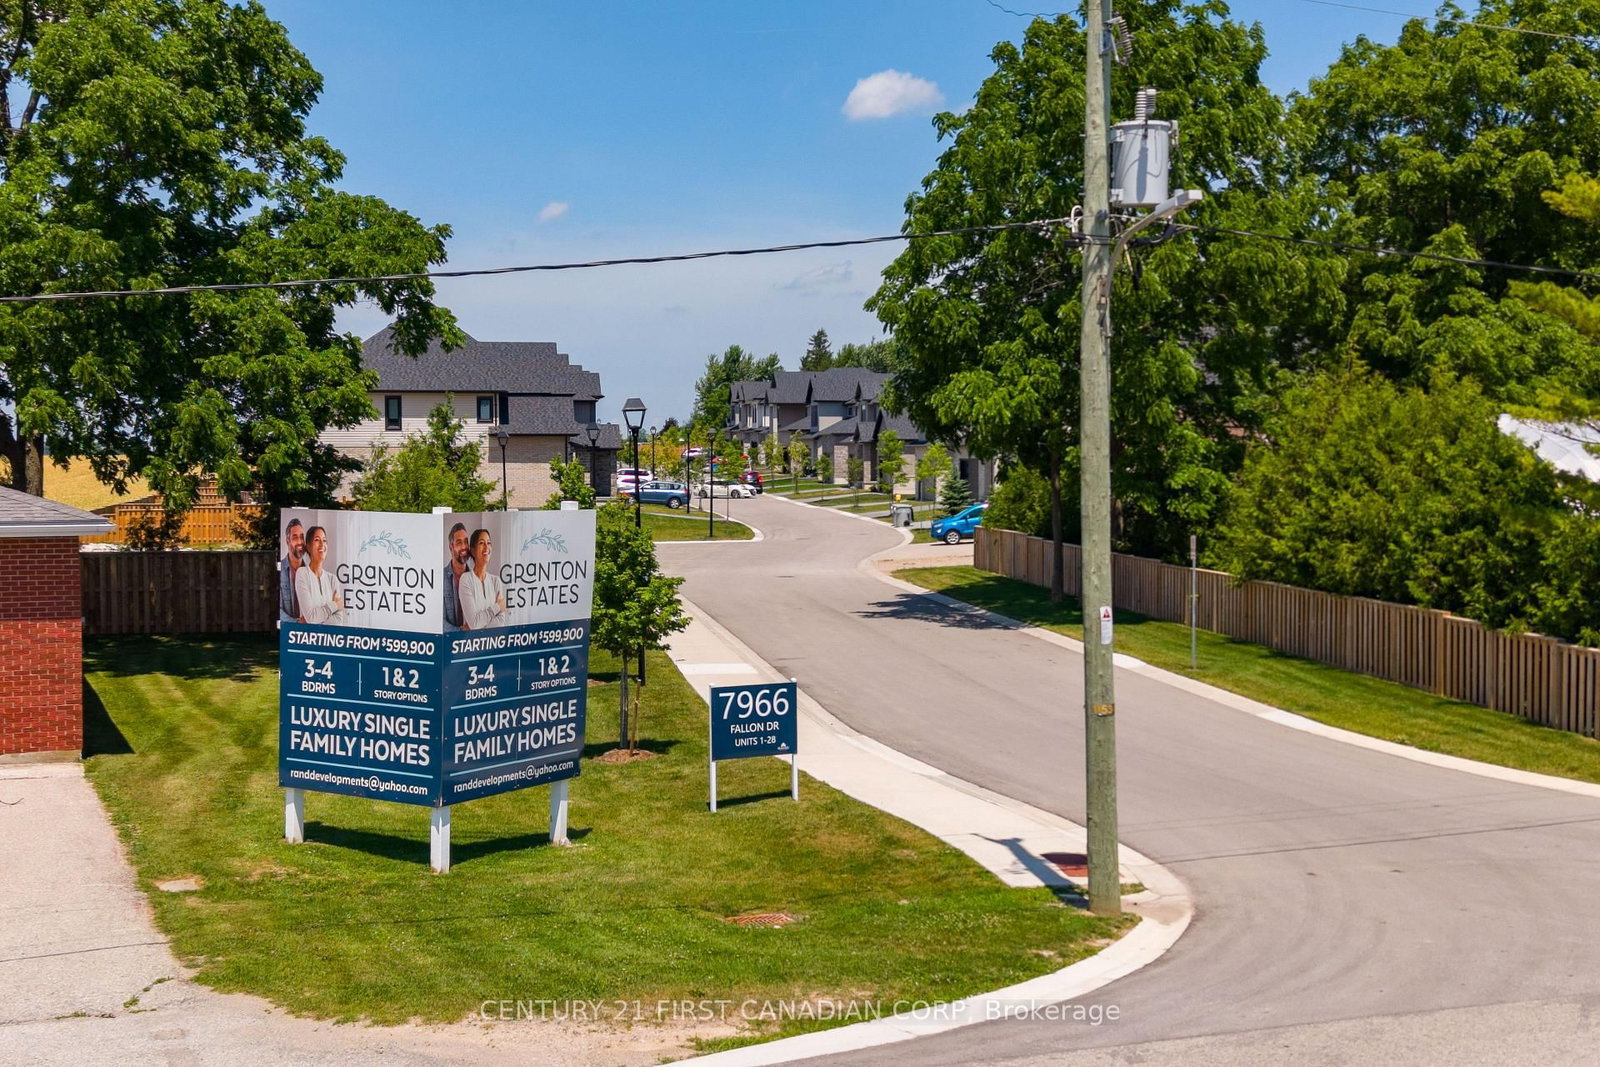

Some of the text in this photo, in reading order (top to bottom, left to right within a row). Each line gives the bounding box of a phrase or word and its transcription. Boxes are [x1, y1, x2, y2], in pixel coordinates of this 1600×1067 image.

[344, 589, 426, 614] ESTATES
[506, 584, 579, 609] ESTATES
[288, 631, 434, 656] STARTING FROM $599,900
[452, 627, 583, 654] STARTING FROM $599,900
[304, 659, 332, 679] 3-4
[382, 666, 419, 688] 1 & 2
[468, 664, 494, 685] 3-4
[539, 655, 569, 676] 1 & 2
[302, 681, 336, 694] BDRMS
[374, 689, 428, 703] STORY OPTIONS
[465, 685, 497, 700] BDRMS
[531, 676, 576, 691] STORY OPTIONS
[719, 688, 789, 720] 7966
[291, 706, 430, 739] LUXURY SINGLE
[454, 699, 577, 737] LUXURY SINGLE
[730, 721, 779, 734] FALLON DR
[290, 730, 430, 766] FAMILY HOMES
[454, 723, 576, 764] FAMILY HOMES
[735, 736, 776, 747] UNITS 1-28
[290, 769, 428, 796] randdevelopments@yahoo.com
[454, 760, 573, 793] randdevelopments@yahoo.com
